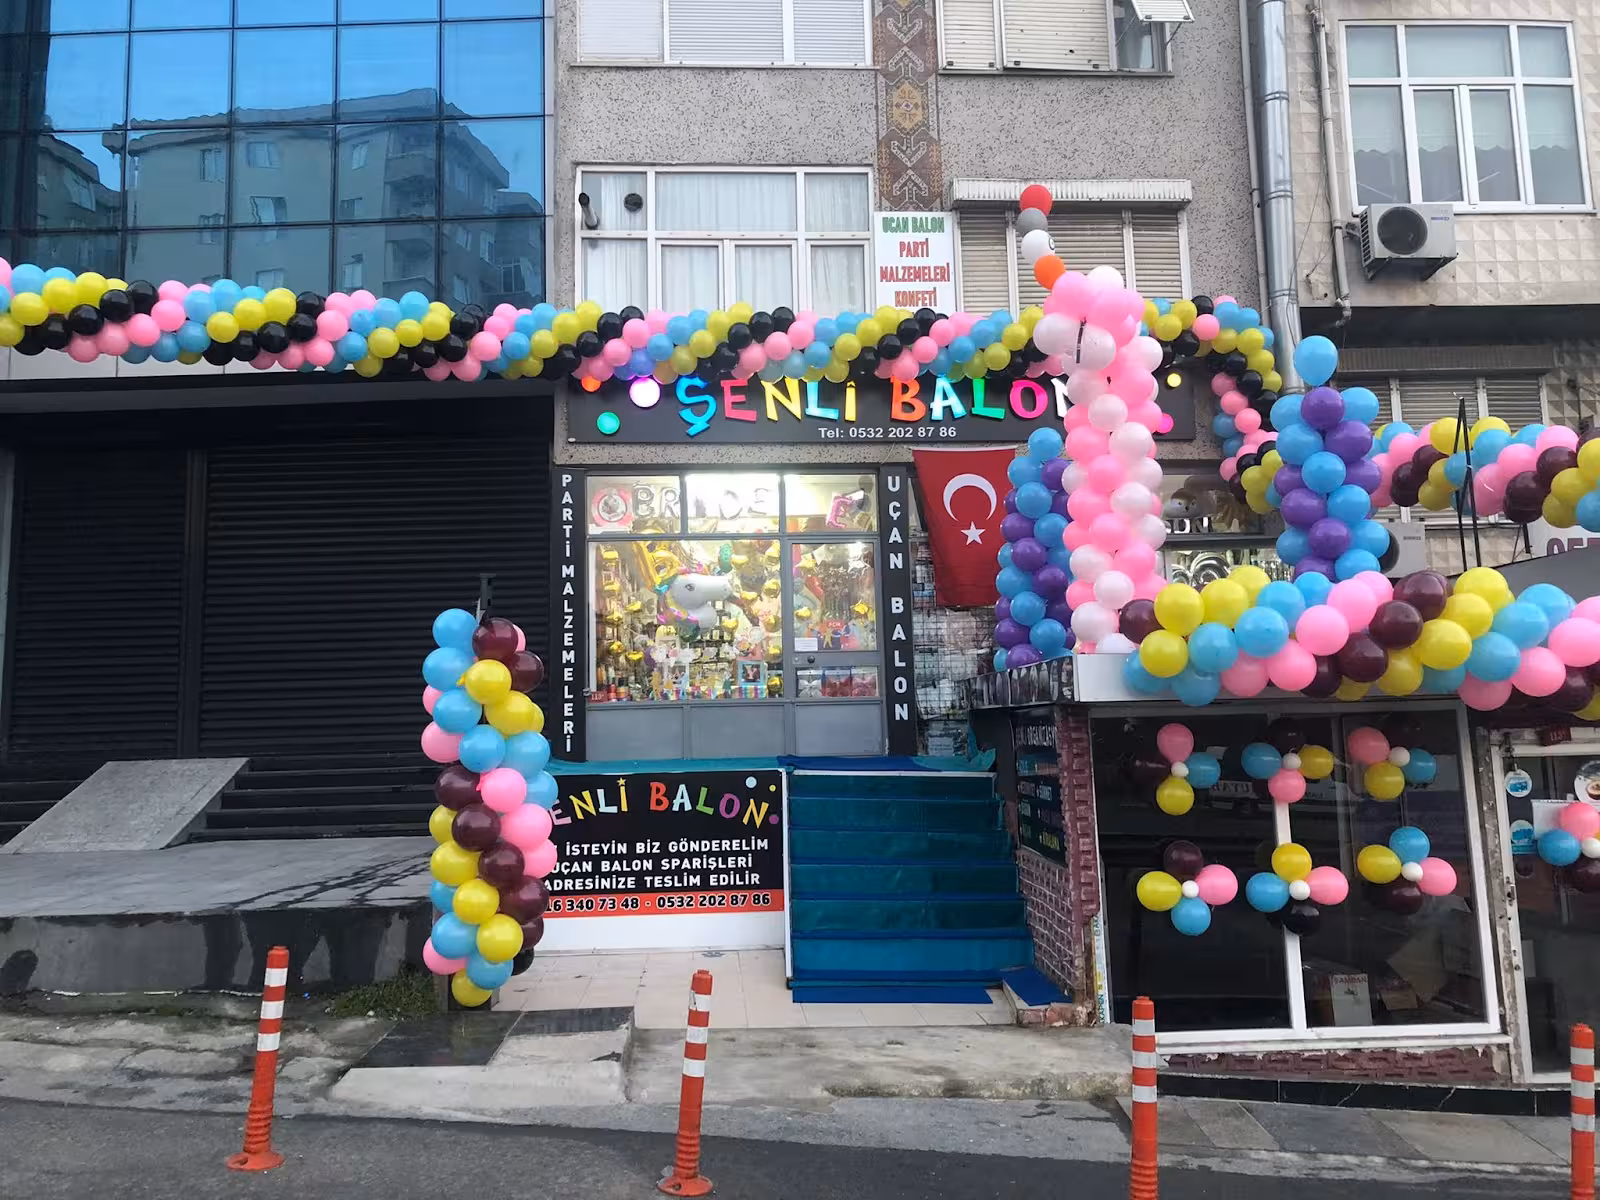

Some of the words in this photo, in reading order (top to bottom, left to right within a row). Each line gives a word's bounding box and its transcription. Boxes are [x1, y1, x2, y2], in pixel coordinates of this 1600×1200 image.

[911, 216, 945, 233] BALON
[899, 238, 930, 258] PARTİ
[879, 262, 951, 283] MALZEMELERİ
[894, 287, 938, 308] KONFETİ
[675, 375, 857, 436] ŞENLİ
[818, 427, 844, 438] Tel:
[849, 427, 884, 438] 0532
[888, 427, 913, 438] 202
[918, 427, 935, 438] 87
[939, 427, 957, 438] 86
[560, 474, 574, 557] PARTİ
[887, 476, 904, 571] UÇAN
[560, 564, 575, 753] MALZEMELERİ
[890, 597, 911, 721] BALON
[549, 777, 629, 826] ENLİ
[649, 781, 769, 829] BALON
[565, 838, 627, 856] İSTEYİN
[636, 837, 661, 854] BİZ
[668, 835, 769, 853] GÖNDERELİM
[600, 858, 653, 871] BALON
[661, 853, 753, 871] SPARİŞLERİ
[544, 874, 636, 891] ADRESİNİZE
[644, 872, 701, 888] TESLİM
[709, 870, 761, 886] EDİLİR
[546, 898, 563, 912] 16
[565, 897, 595, 912] 340
[597, 896, 617, 911] 73
[620, 895, 640, 910] 48
[656, 894, 695, 909] 0532
[698, 892, 727, 907] 202
[730, 892, 749, 906] 87
[751, 891, 772, 906] 86
